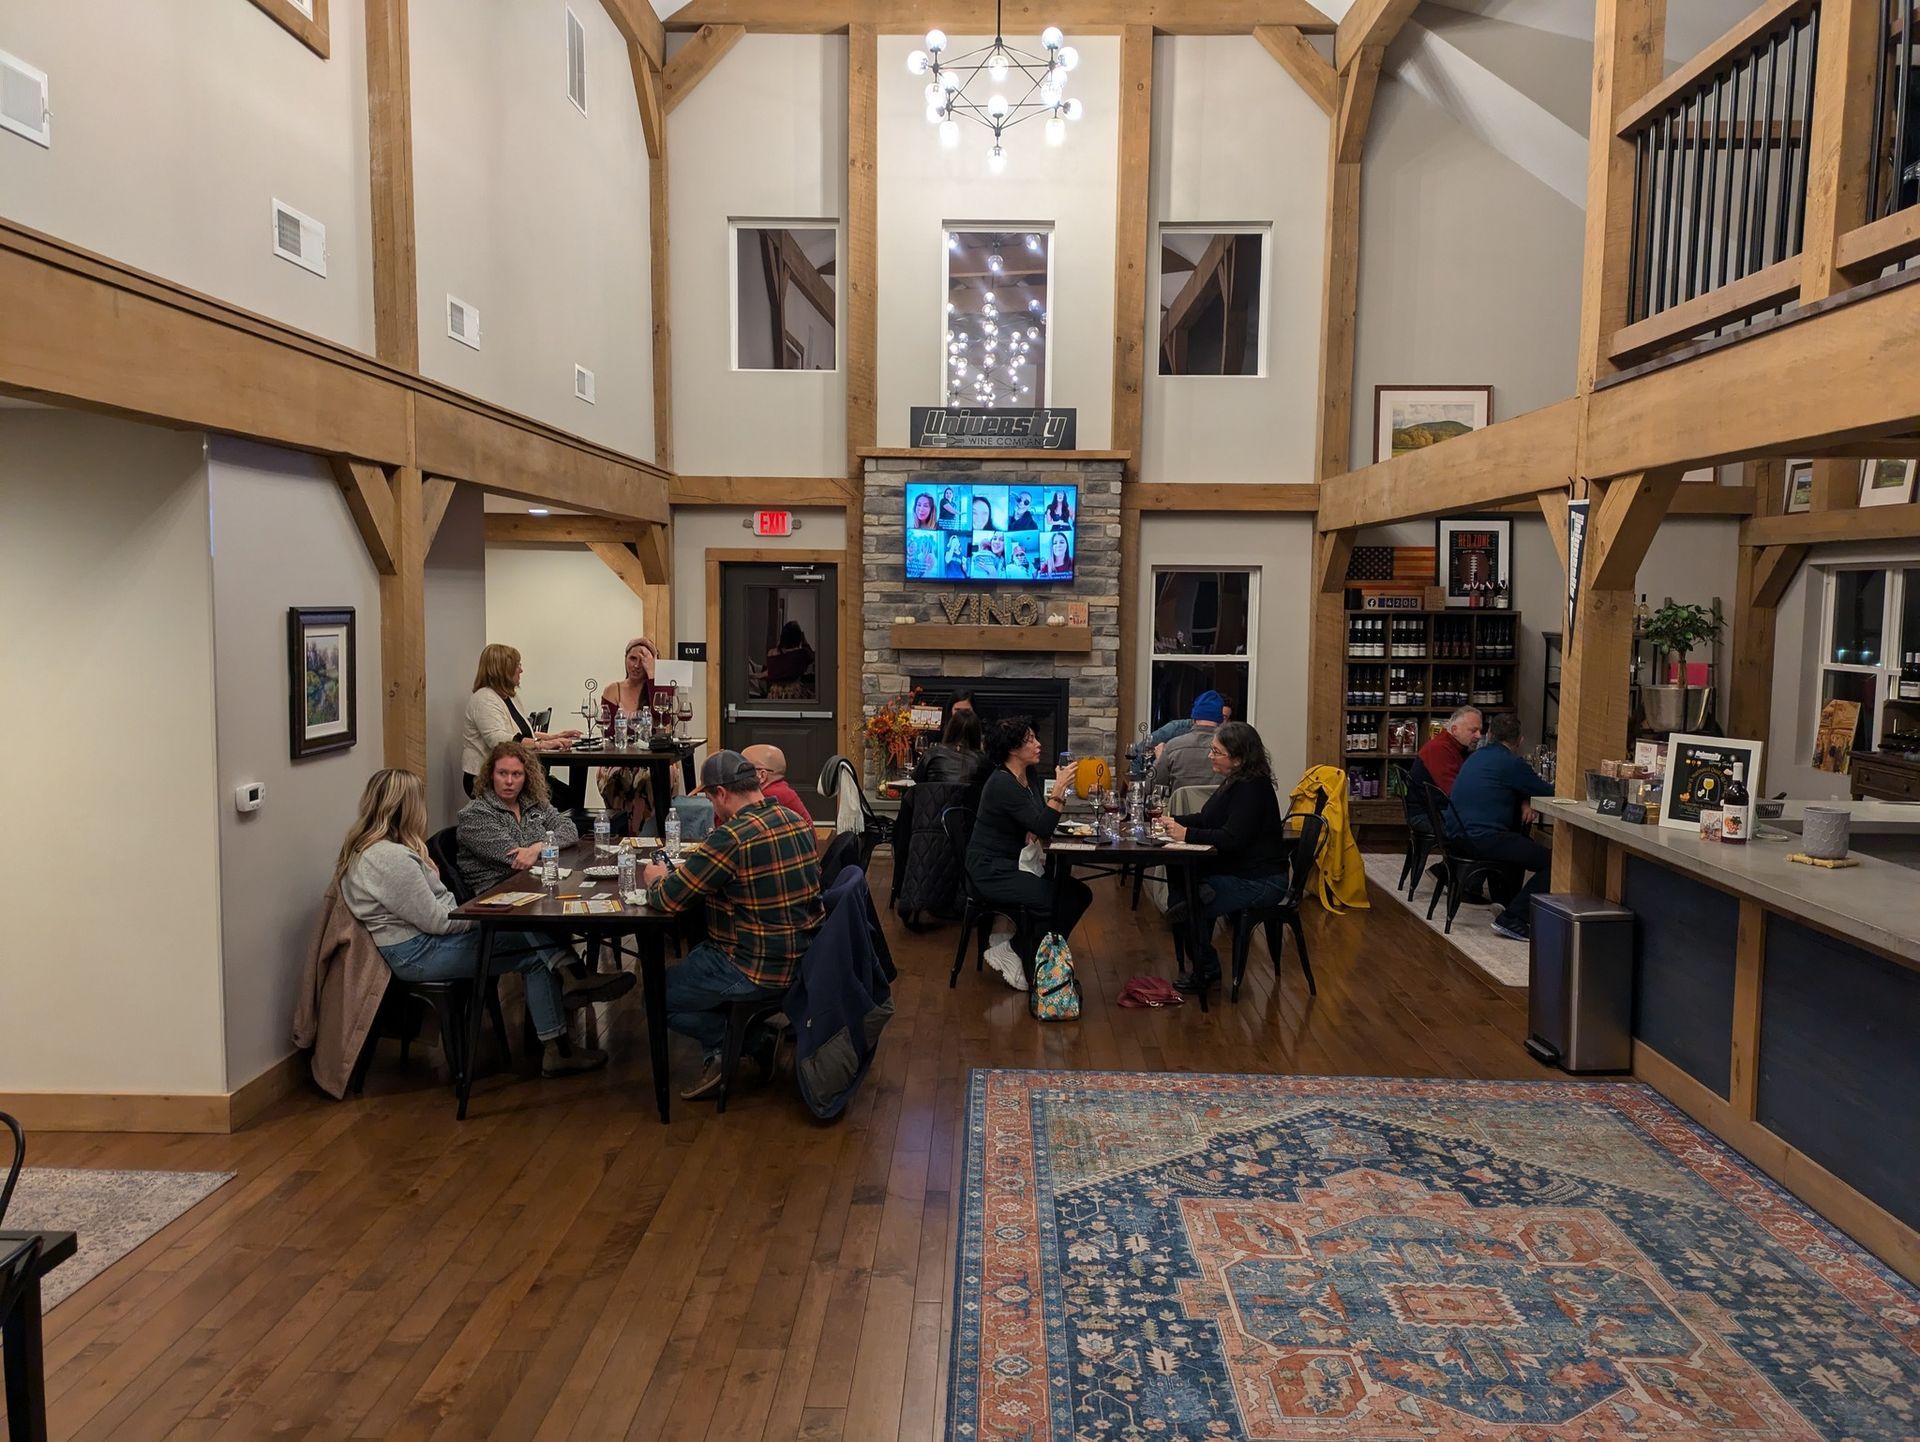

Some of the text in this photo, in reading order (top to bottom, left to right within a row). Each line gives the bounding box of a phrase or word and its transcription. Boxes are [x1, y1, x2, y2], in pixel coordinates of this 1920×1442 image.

[968, 437, 994, 446] WINE
[760, 512, 788, 534] EXIT
[938, 593, 1039, 627] VINO
[685, 647, 700, 655] EXIT
